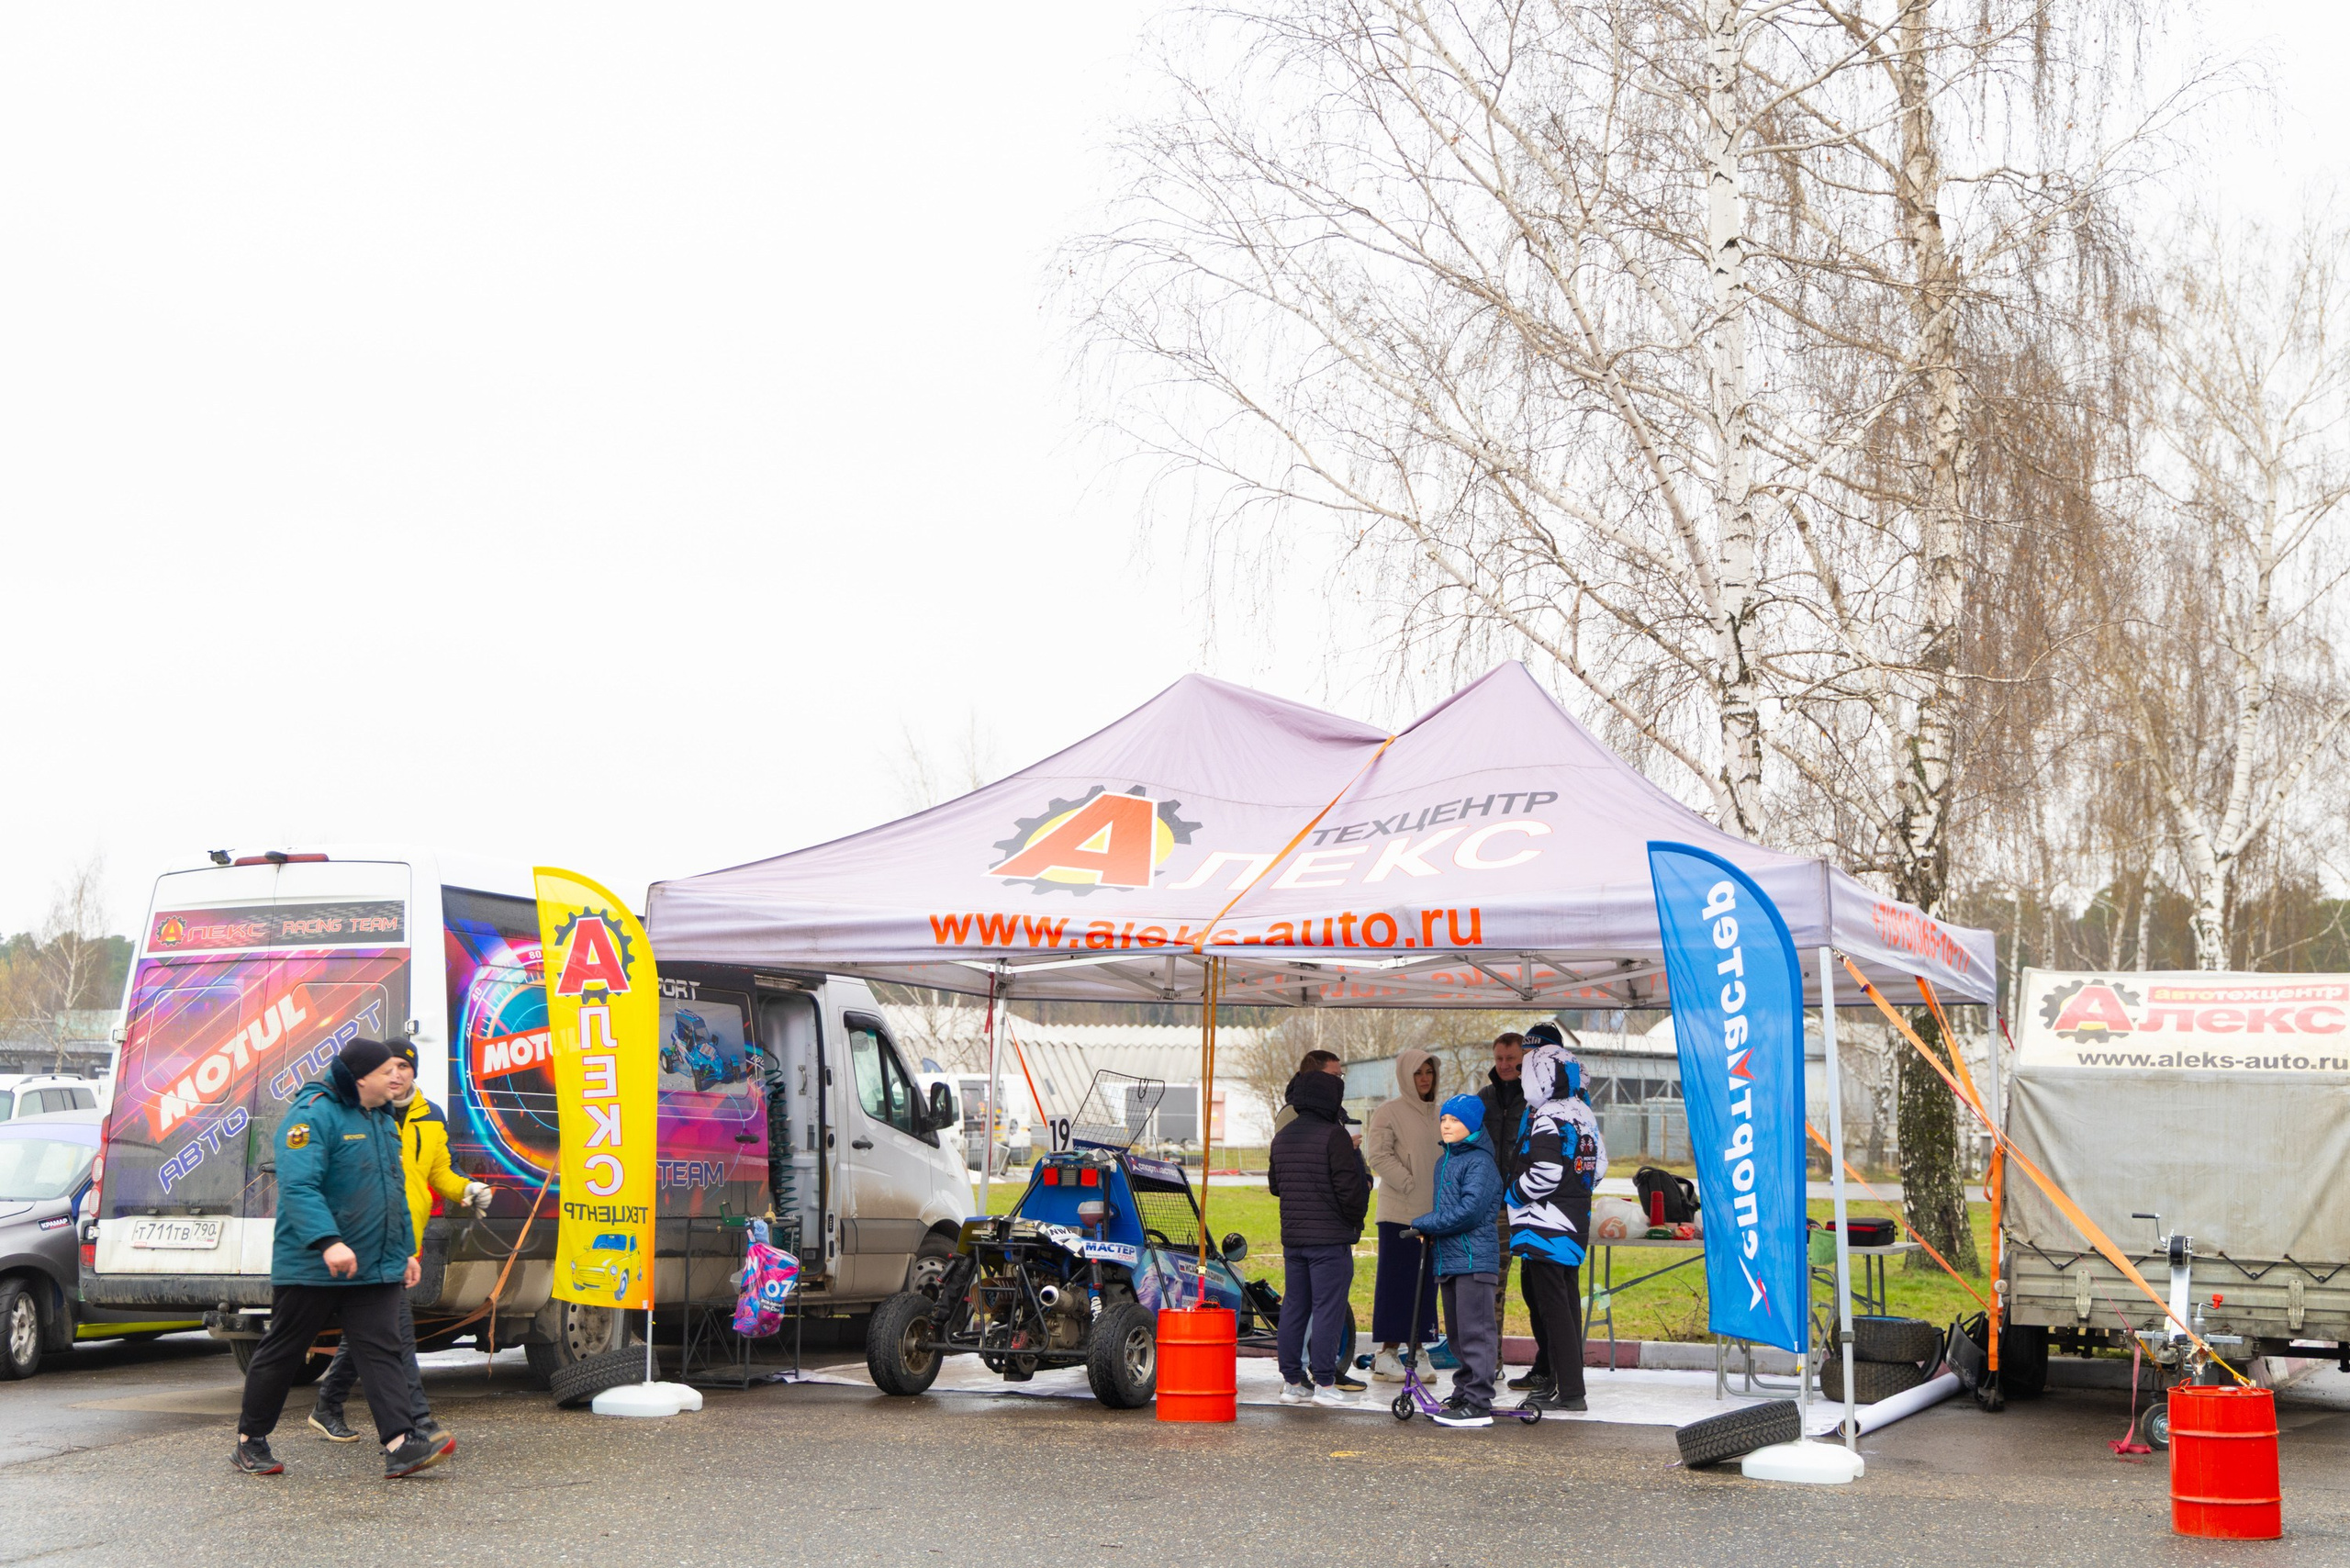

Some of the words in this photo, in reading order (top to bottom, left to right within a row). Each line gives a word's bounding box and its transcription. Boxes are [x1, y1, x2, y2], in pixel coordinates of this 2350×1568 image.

[1312, 790, 1559, 846] ТЕХЦЕНТР
[282, 918, 342, 935] RACING
[350, 917, 397, 933] TEAM
[658, 977, 701, 1001] PORT
[2154, 985, 2343, 1002] автотехцентр
[160, 993, 307, 1133] MOTUL
[2077, 1051, 2350, 1070] www.aleks-auto.ru
[158, 1105, 250, 1194] АВТО
[269, 998, 381, 1100] СПОРТ
[1049, 1117, 1070, 1152] 19
[656, 1159, 724, 1190] TEAM
[40, 1218, 68, 1228] КРАМАР
[194, 1223, 216, 1236] 790
[1086, 1242, 1136, 1255] МАСТЕР
